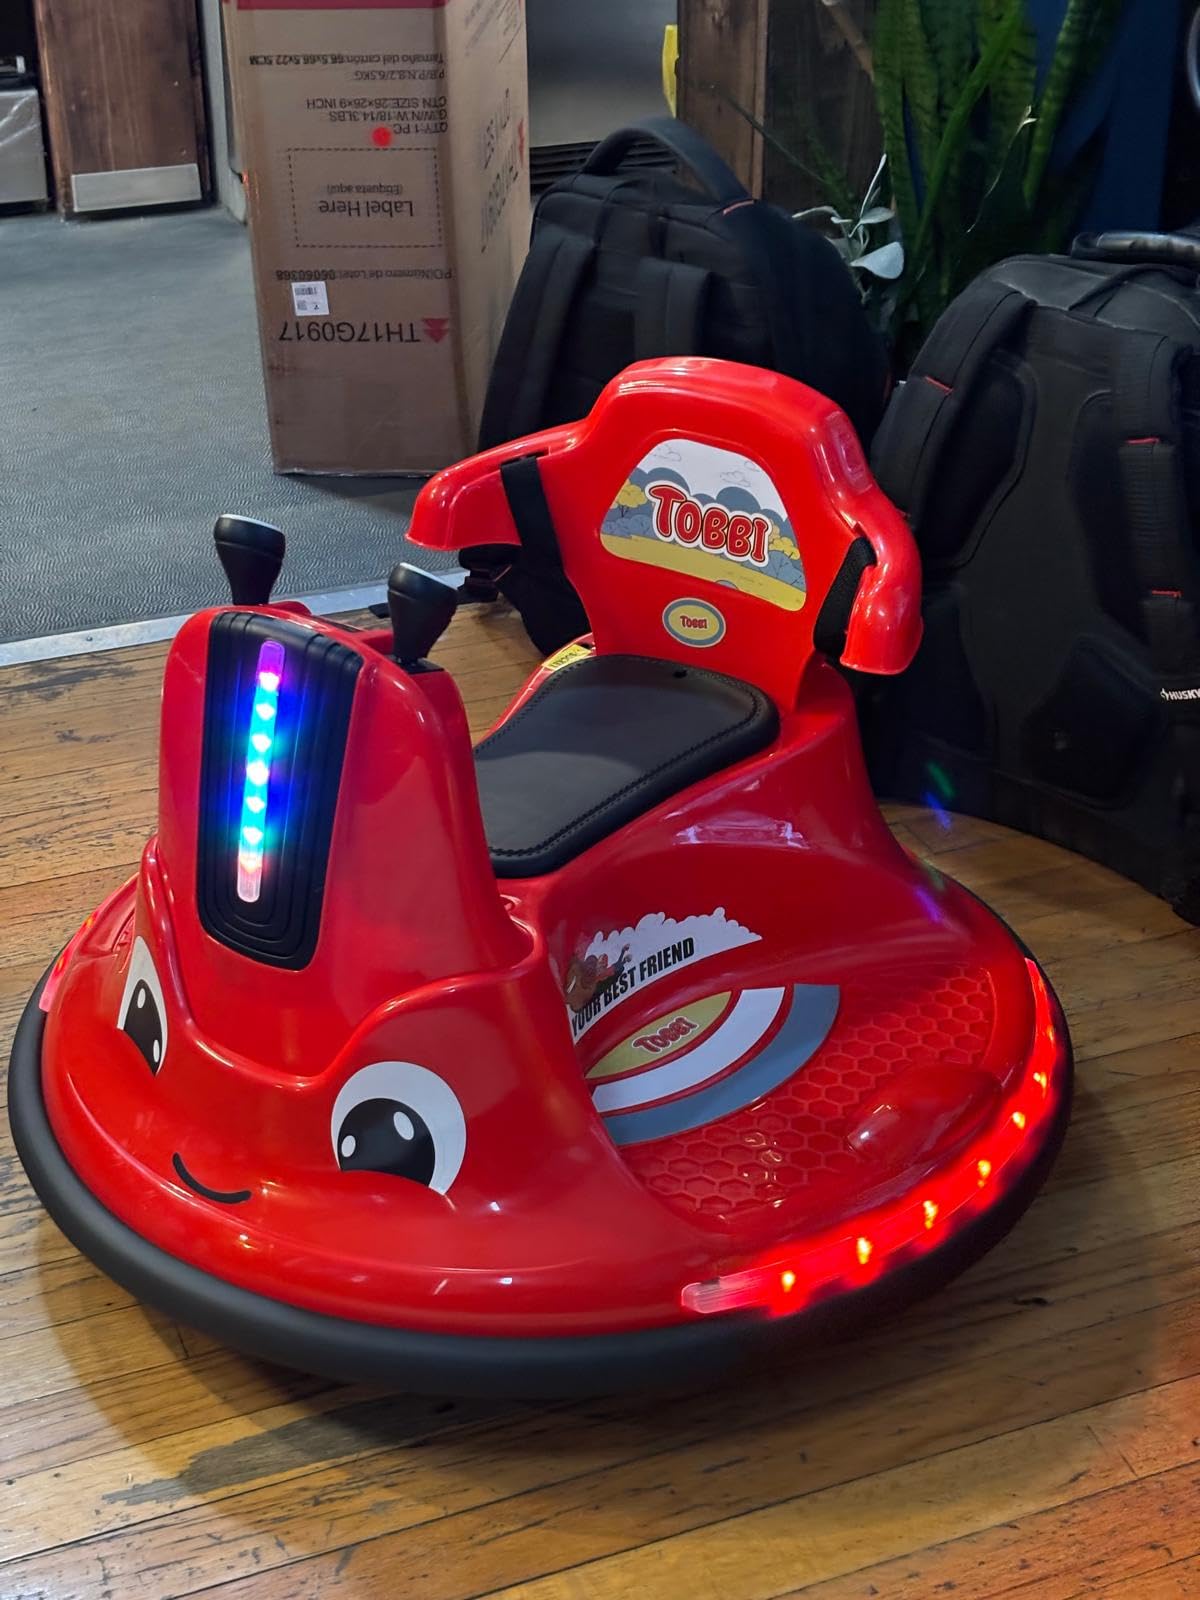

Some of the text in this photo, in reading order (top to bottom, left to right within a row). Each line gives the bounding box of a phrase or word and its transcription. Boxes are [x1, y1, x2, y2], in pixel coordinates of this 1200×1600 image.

[306, 98, 336, 109] INCH
[422, 95, 447, 107] CTN
[393, 122, 411, 134] PC
[319, 200, 414, 217] Label Here
[278, 320, 420, 343] TH17G0917
[648, 484, 769, 563] TOBBI
[572, 937, 695, 1037] YOUR BEST FRIEND
